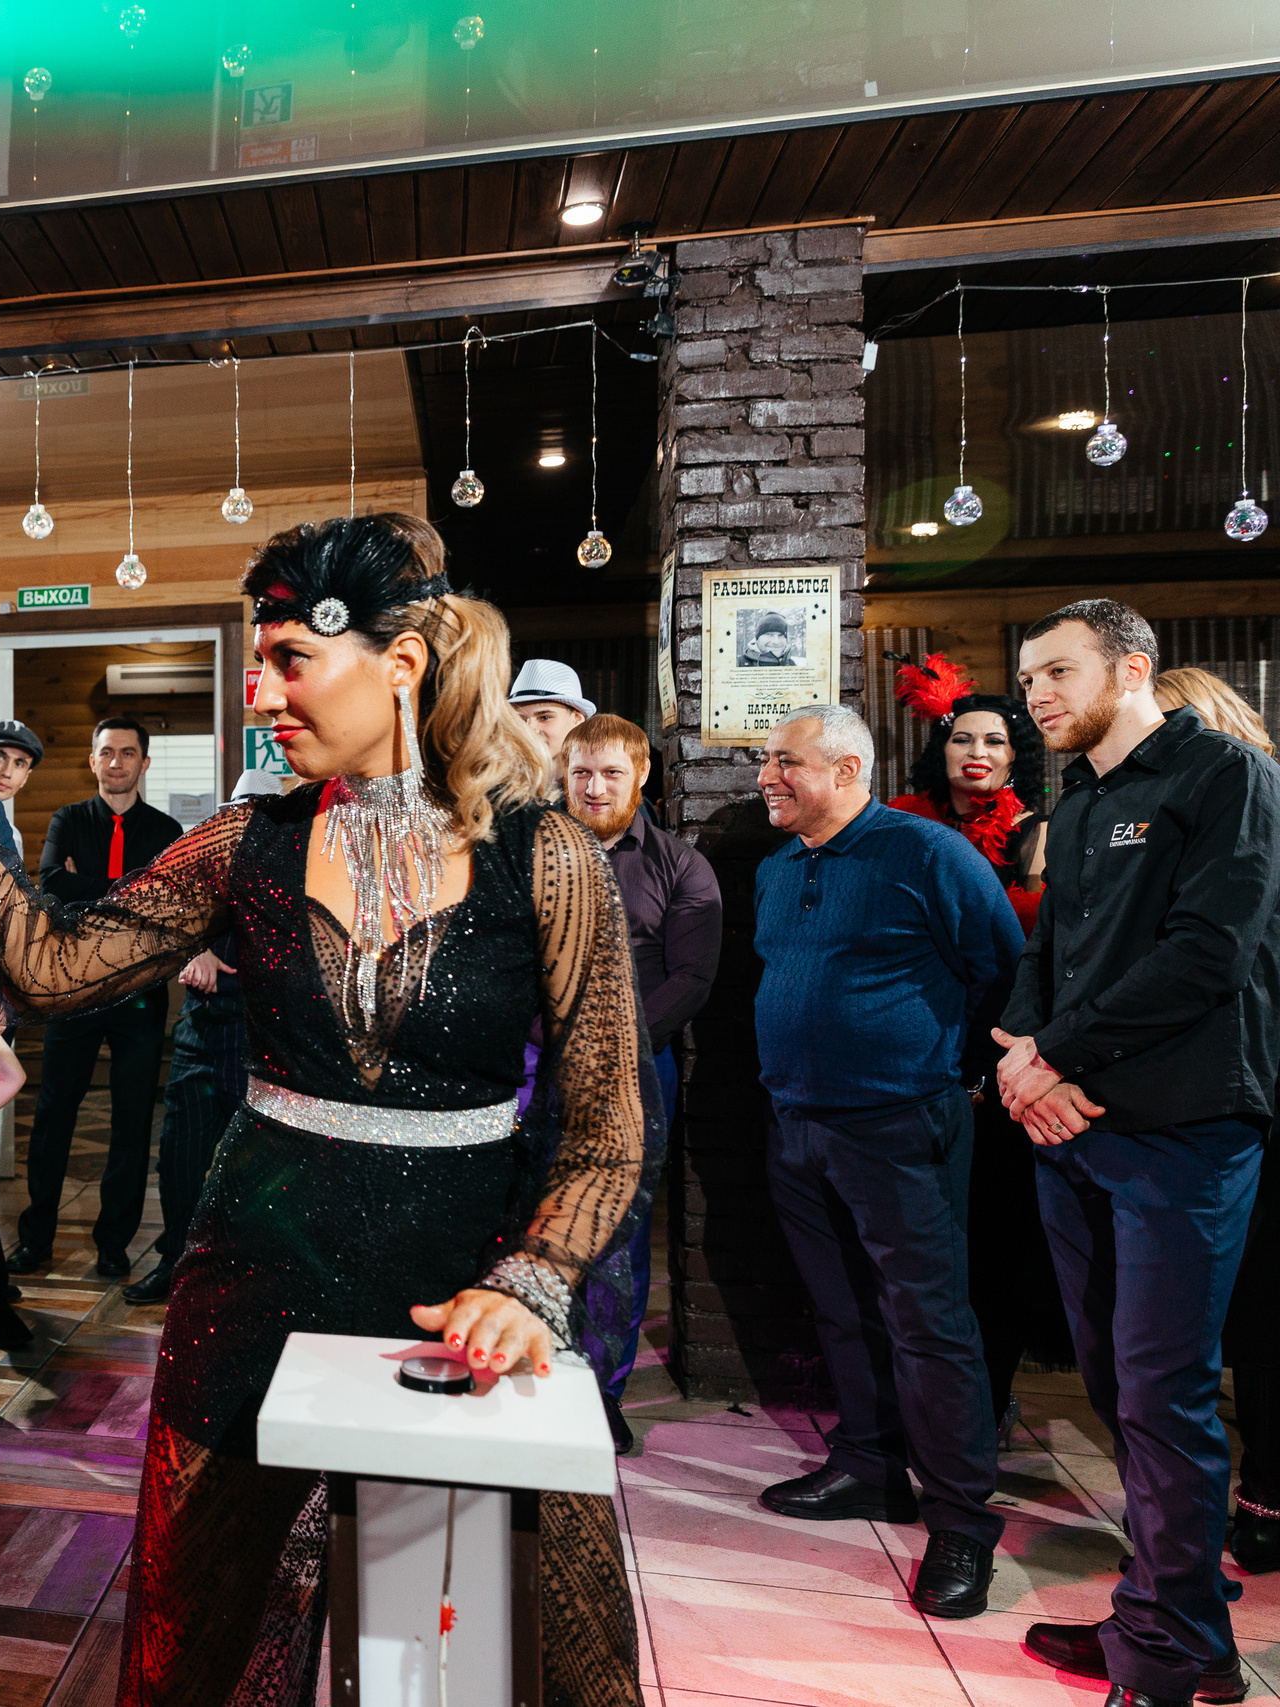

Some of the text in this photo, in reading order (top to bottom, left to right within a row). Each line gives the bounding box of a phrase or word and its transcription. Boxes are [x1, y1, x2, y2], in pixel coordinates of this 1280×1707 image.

[712, 578, 830, 597] РАЗЫСКИВАЕТСЯ
[23, 588, 84, 606] ВЫХОД
[747, 703, 792, 715] НАГРАДА
[1110, 822, 1151, 842] EA7
